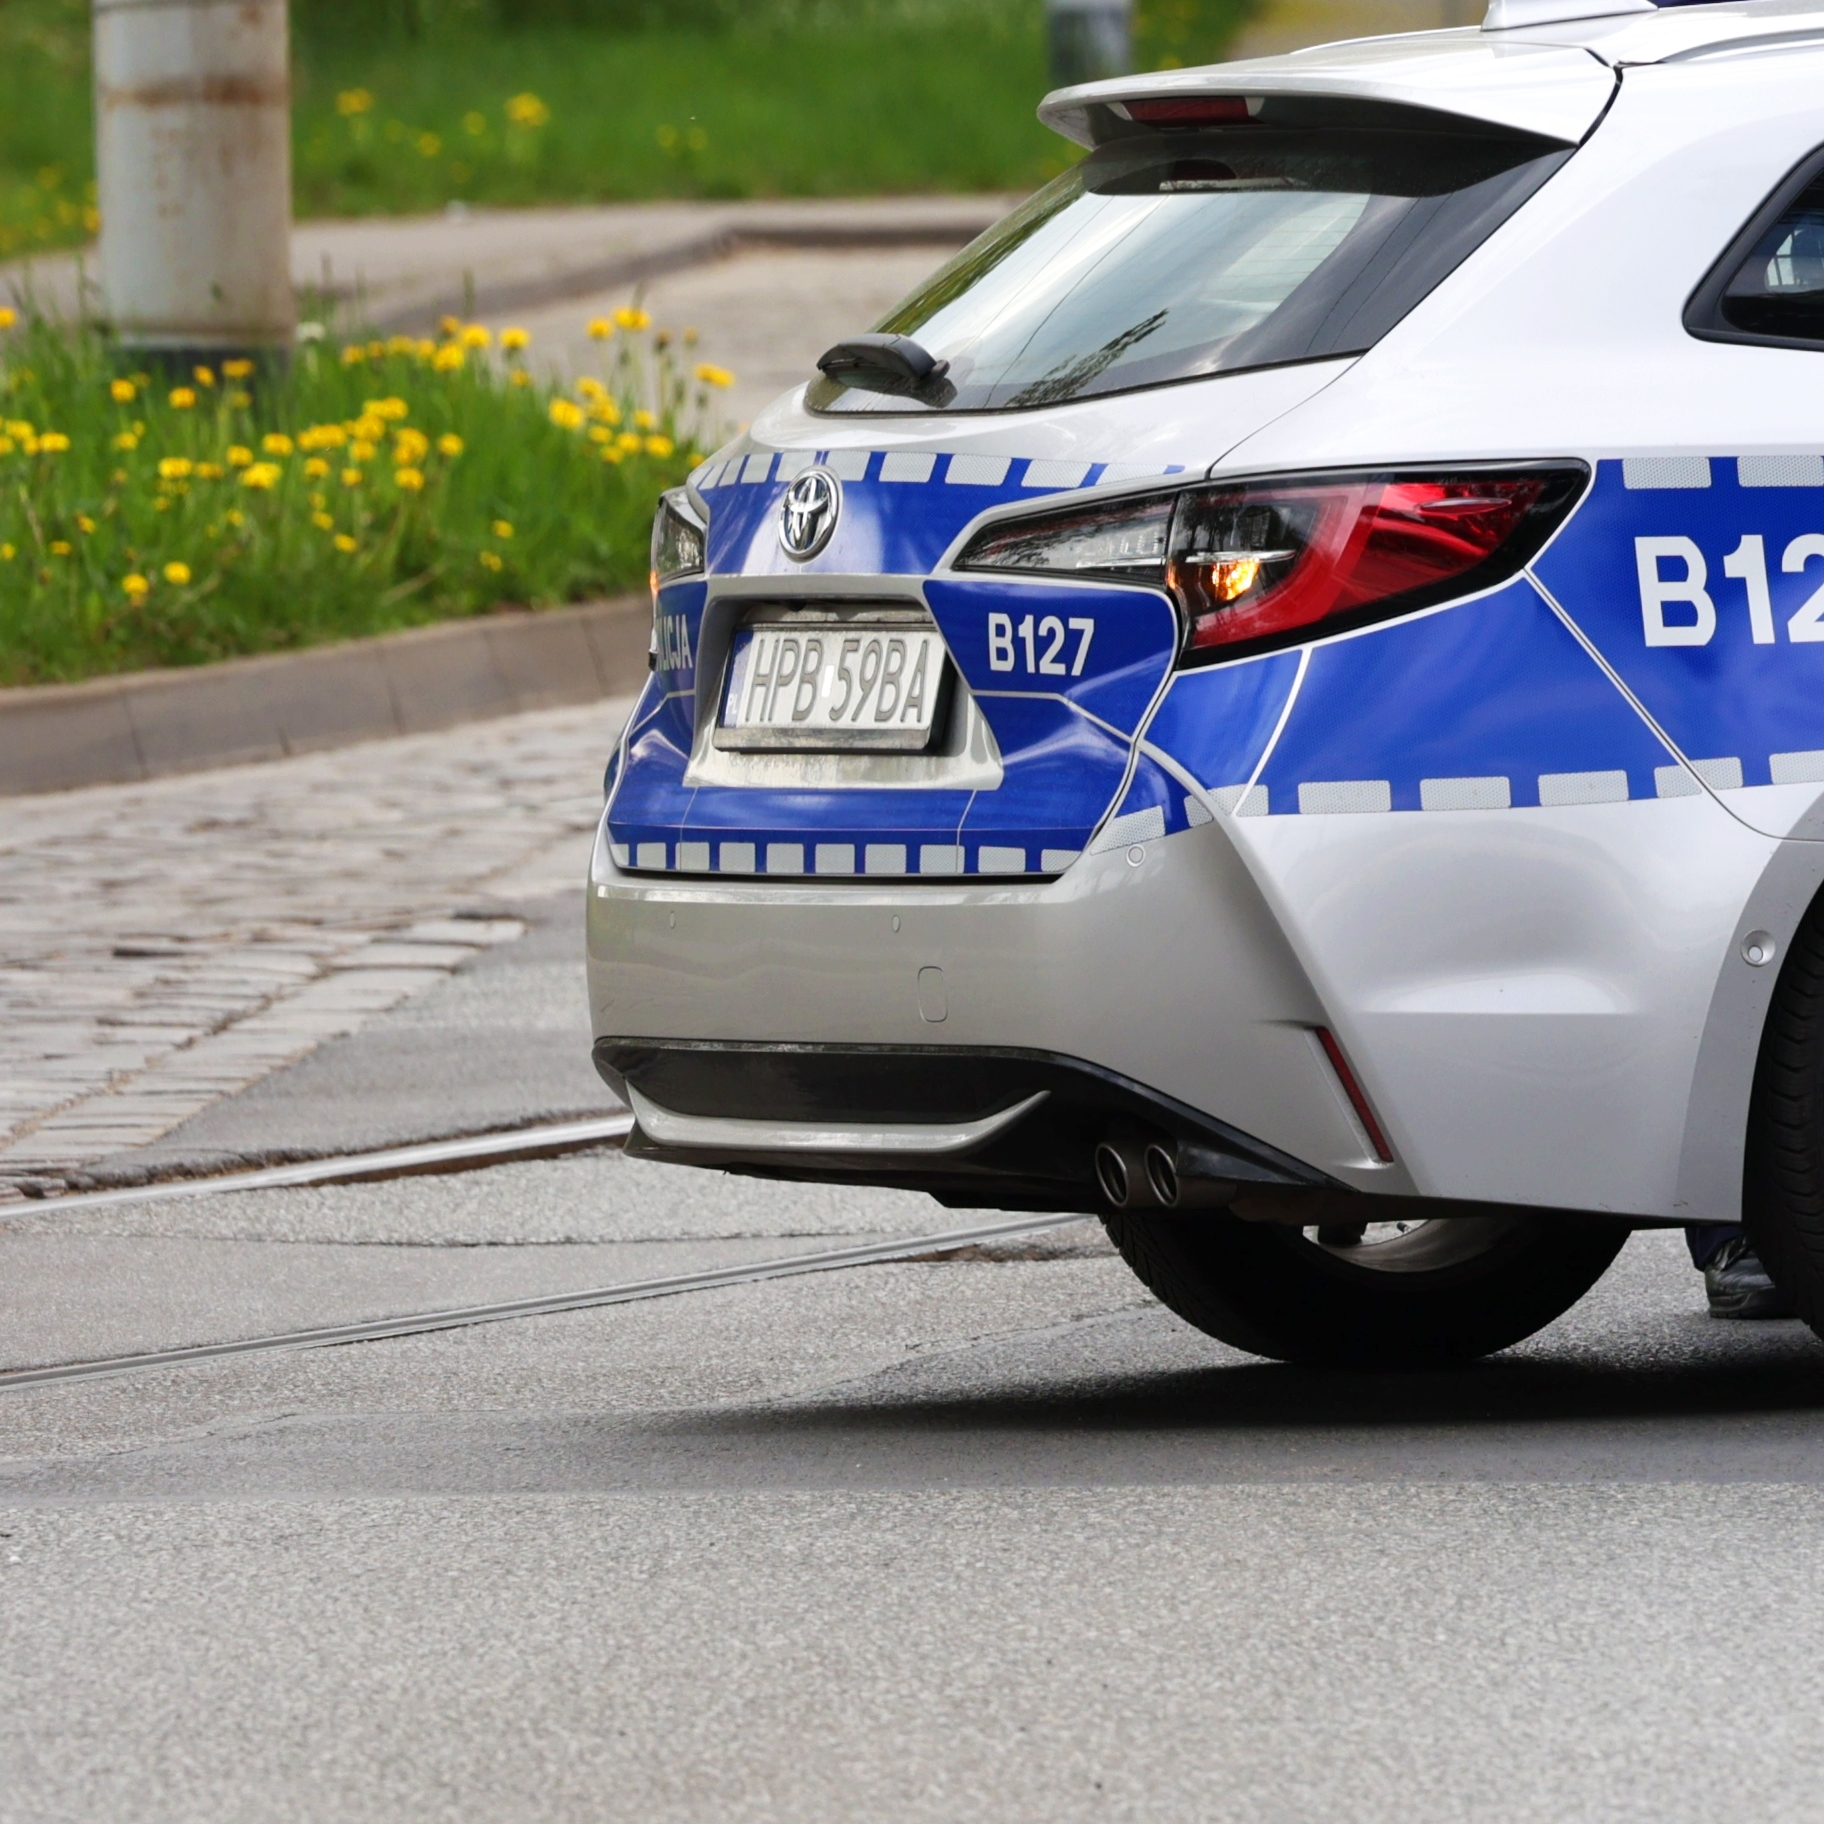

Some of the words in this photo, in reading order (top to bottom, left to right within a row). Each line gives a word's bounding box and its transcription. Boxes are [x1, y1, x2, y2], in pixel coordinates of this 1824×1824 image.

[656, 614, 693, 671] LICJA
[987, 612, 1095, 676] B127
[745, 638, 822, 723] HPB
[829, 637, 930, 724] 59BA
